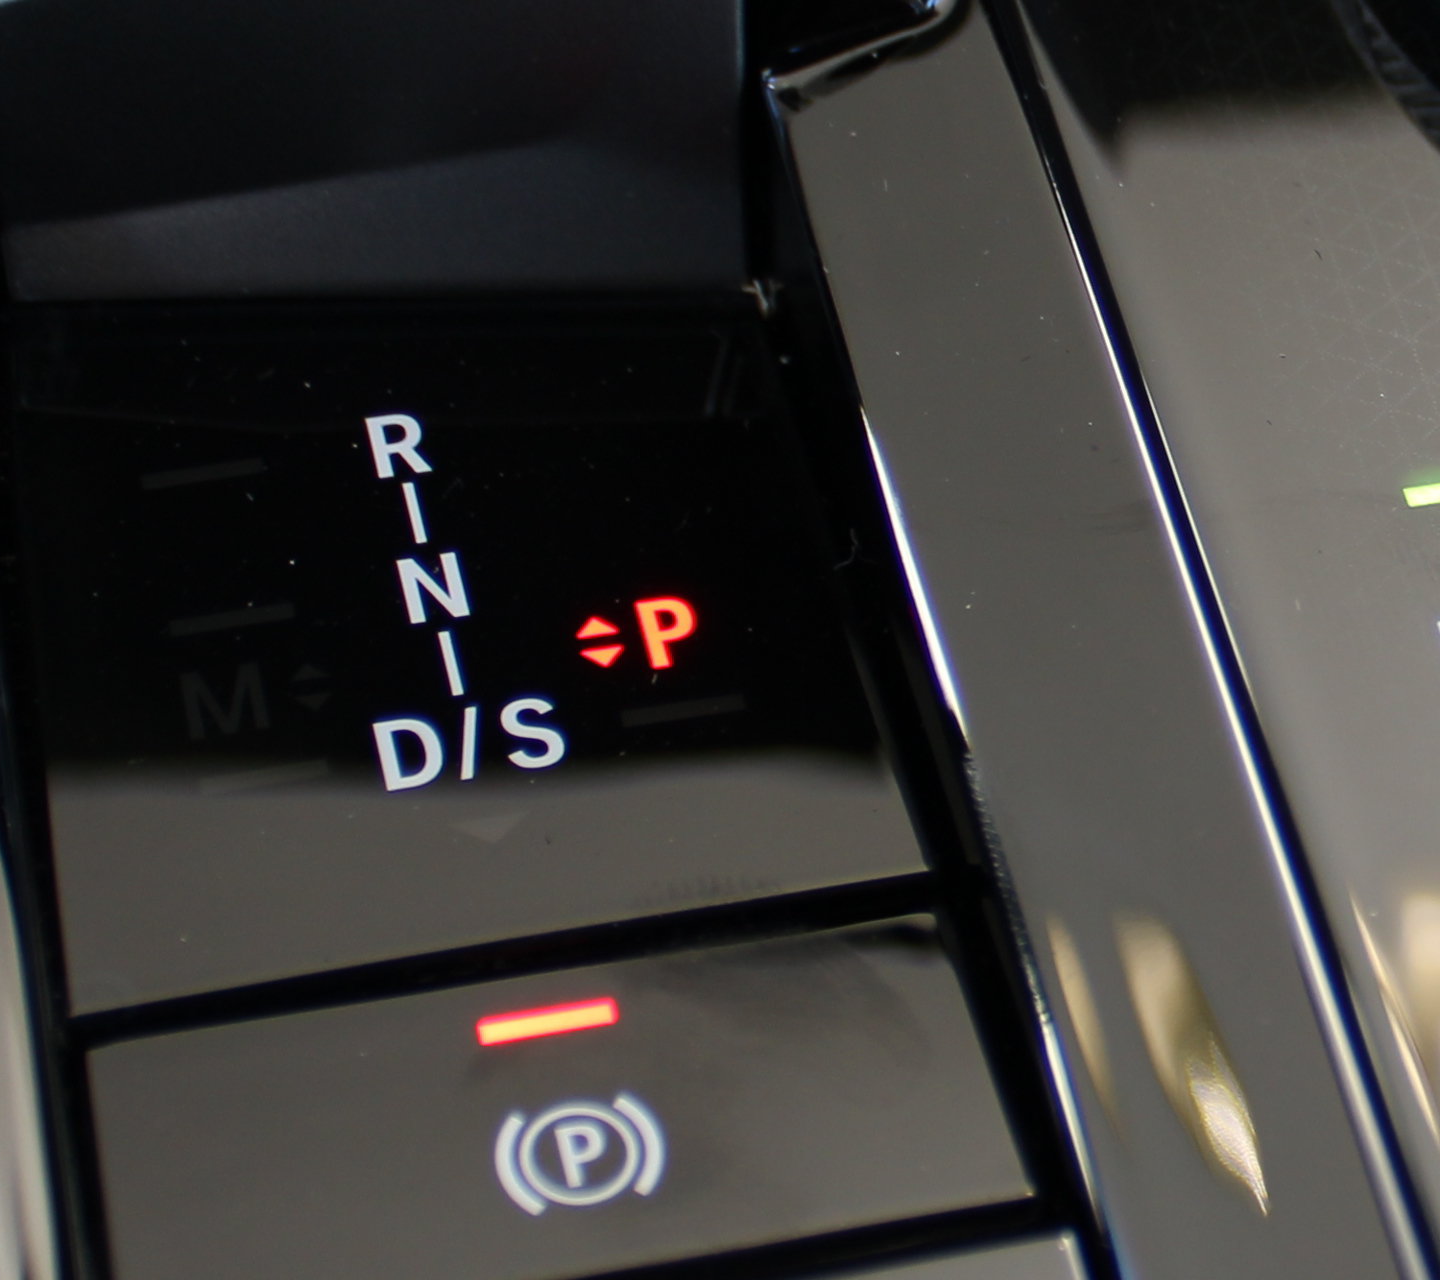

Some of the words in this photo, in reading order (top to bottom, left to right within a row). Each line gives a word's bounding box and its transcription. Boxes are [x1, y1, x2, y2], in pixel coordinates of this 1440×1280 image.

[365, 413, 432, 479] R
[396, 552, 471, 624] N
[634, 596, 697, 669] P
